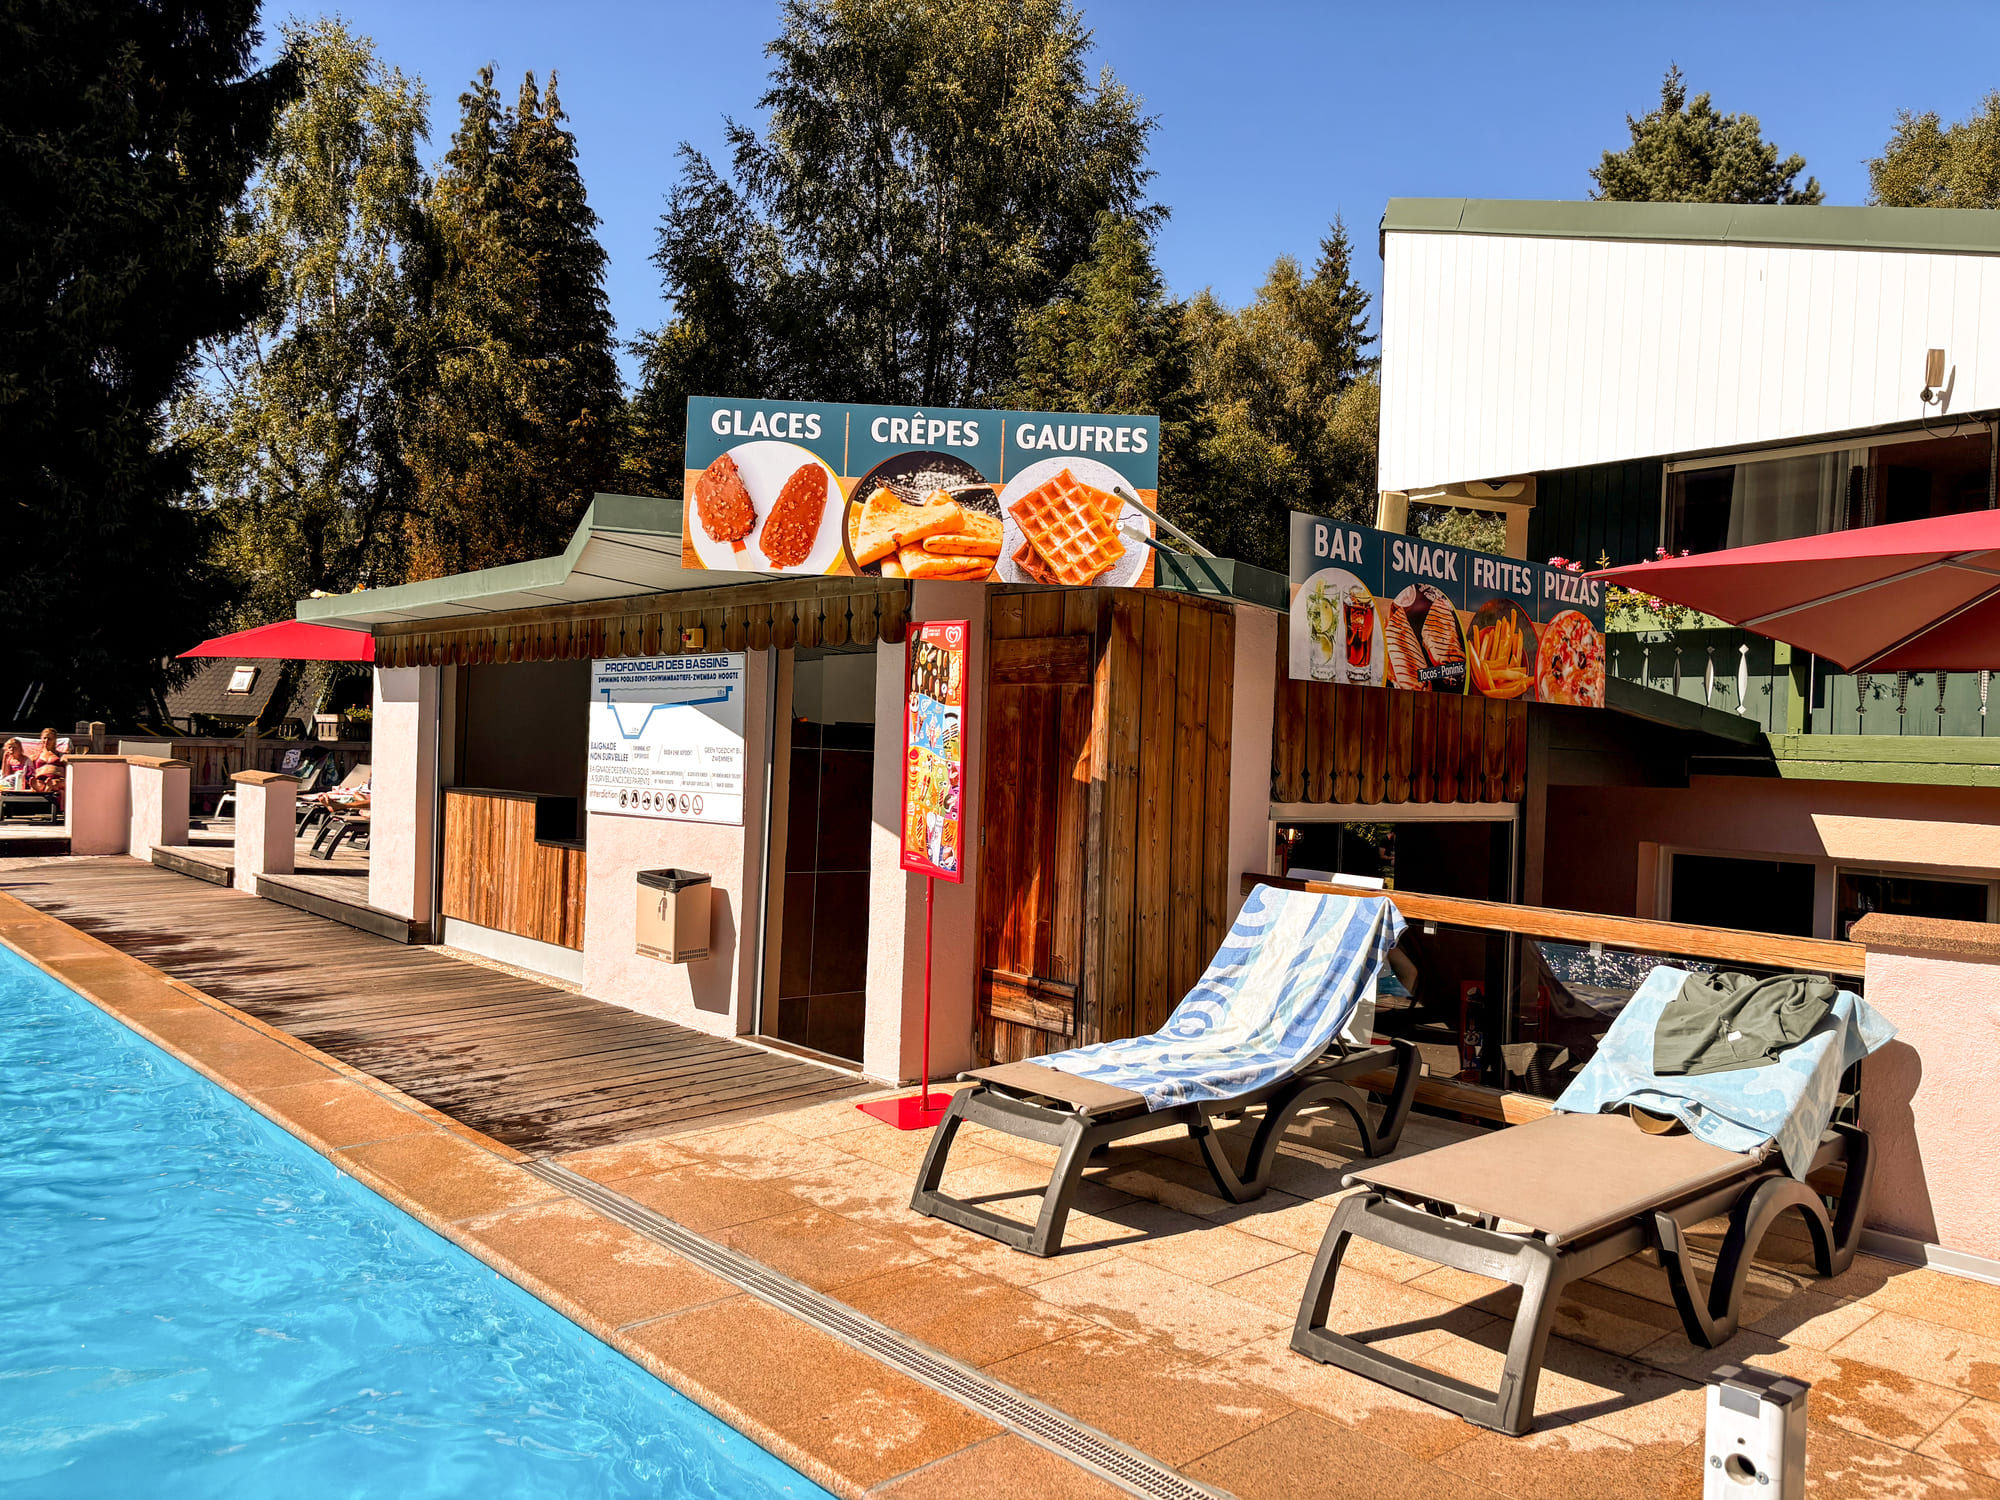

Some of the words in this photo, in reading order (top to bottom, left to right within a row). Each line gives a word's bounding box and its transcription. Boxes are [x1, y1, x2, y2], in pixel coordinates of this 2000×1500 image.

[711, 408, 822, 441] GLACES
[871, 411, 980, 447] CRÊPES
[1016, 423, 1149, 455] GAUFRES
[1314, 523, 1363, 565] BAR
[1392, 539, 1458, 582] SNACK
[1473, 557, 1532, 596] FRITES
[1544, 571, 1600, 608] PIZZAS
[598, 675, 620, 684] SWIMMING
[605, 660, 664, 673] PROFONDEUR
[665, 659, 685, 671] DES
[686, 657, 729, 669] BASSINS
[1419, 669, 1438, 681] Tacos
[1441, 662, 1464, 677] Paninis
